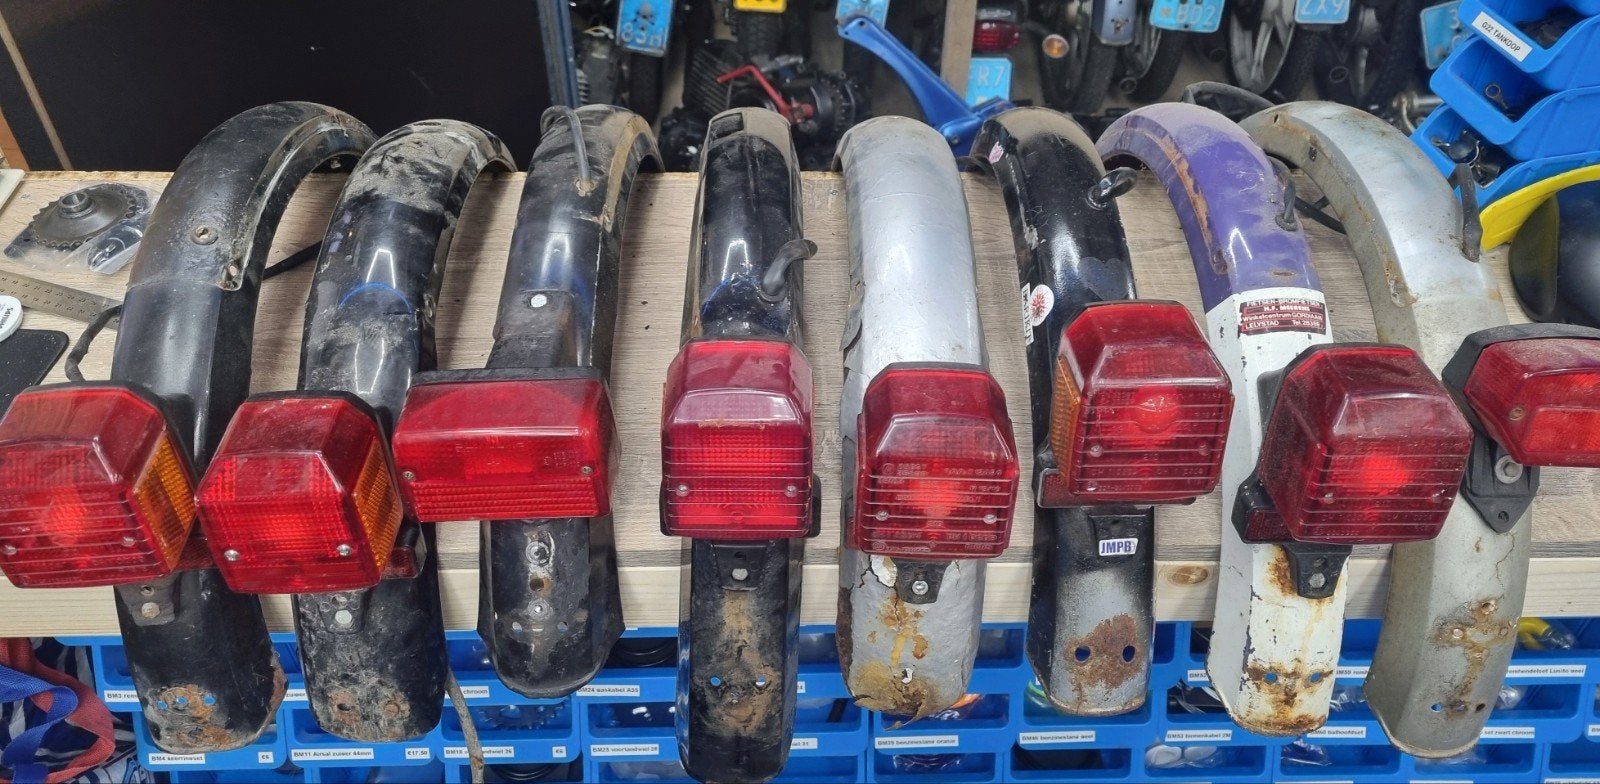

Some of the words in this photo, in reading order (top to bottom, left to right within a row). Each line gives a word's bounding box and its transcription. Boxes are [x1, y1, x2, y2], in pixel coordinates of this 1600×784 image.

[1481, 21, 1494, 33] G22
[1493, 29, 1521, 52] TANKDOP
[1245, 321, 1279, 329] LELYSTAD
[1101, 541, 1132, 554] JMPB
